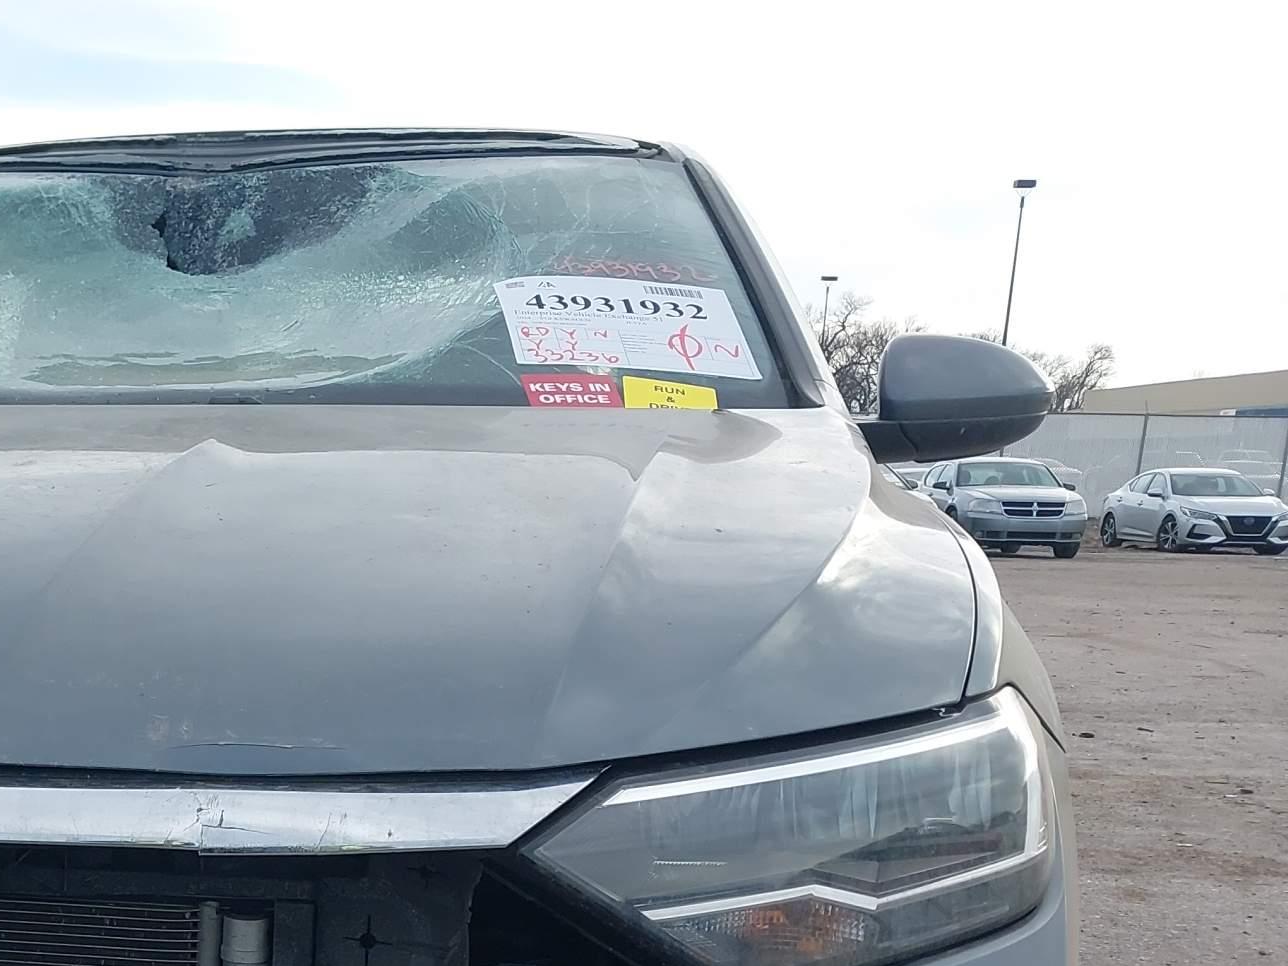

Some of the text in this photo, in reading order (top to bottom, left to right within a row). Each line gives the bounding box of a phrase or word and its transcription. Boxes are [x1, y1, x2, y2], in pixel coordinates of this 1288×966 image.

[526, 294, 708, 320] 43931932
[529, 382, 611, 392] KEYS IN
[653, 385, 686, 396] RUN
[539, 394, 611, 404] OFFICE
